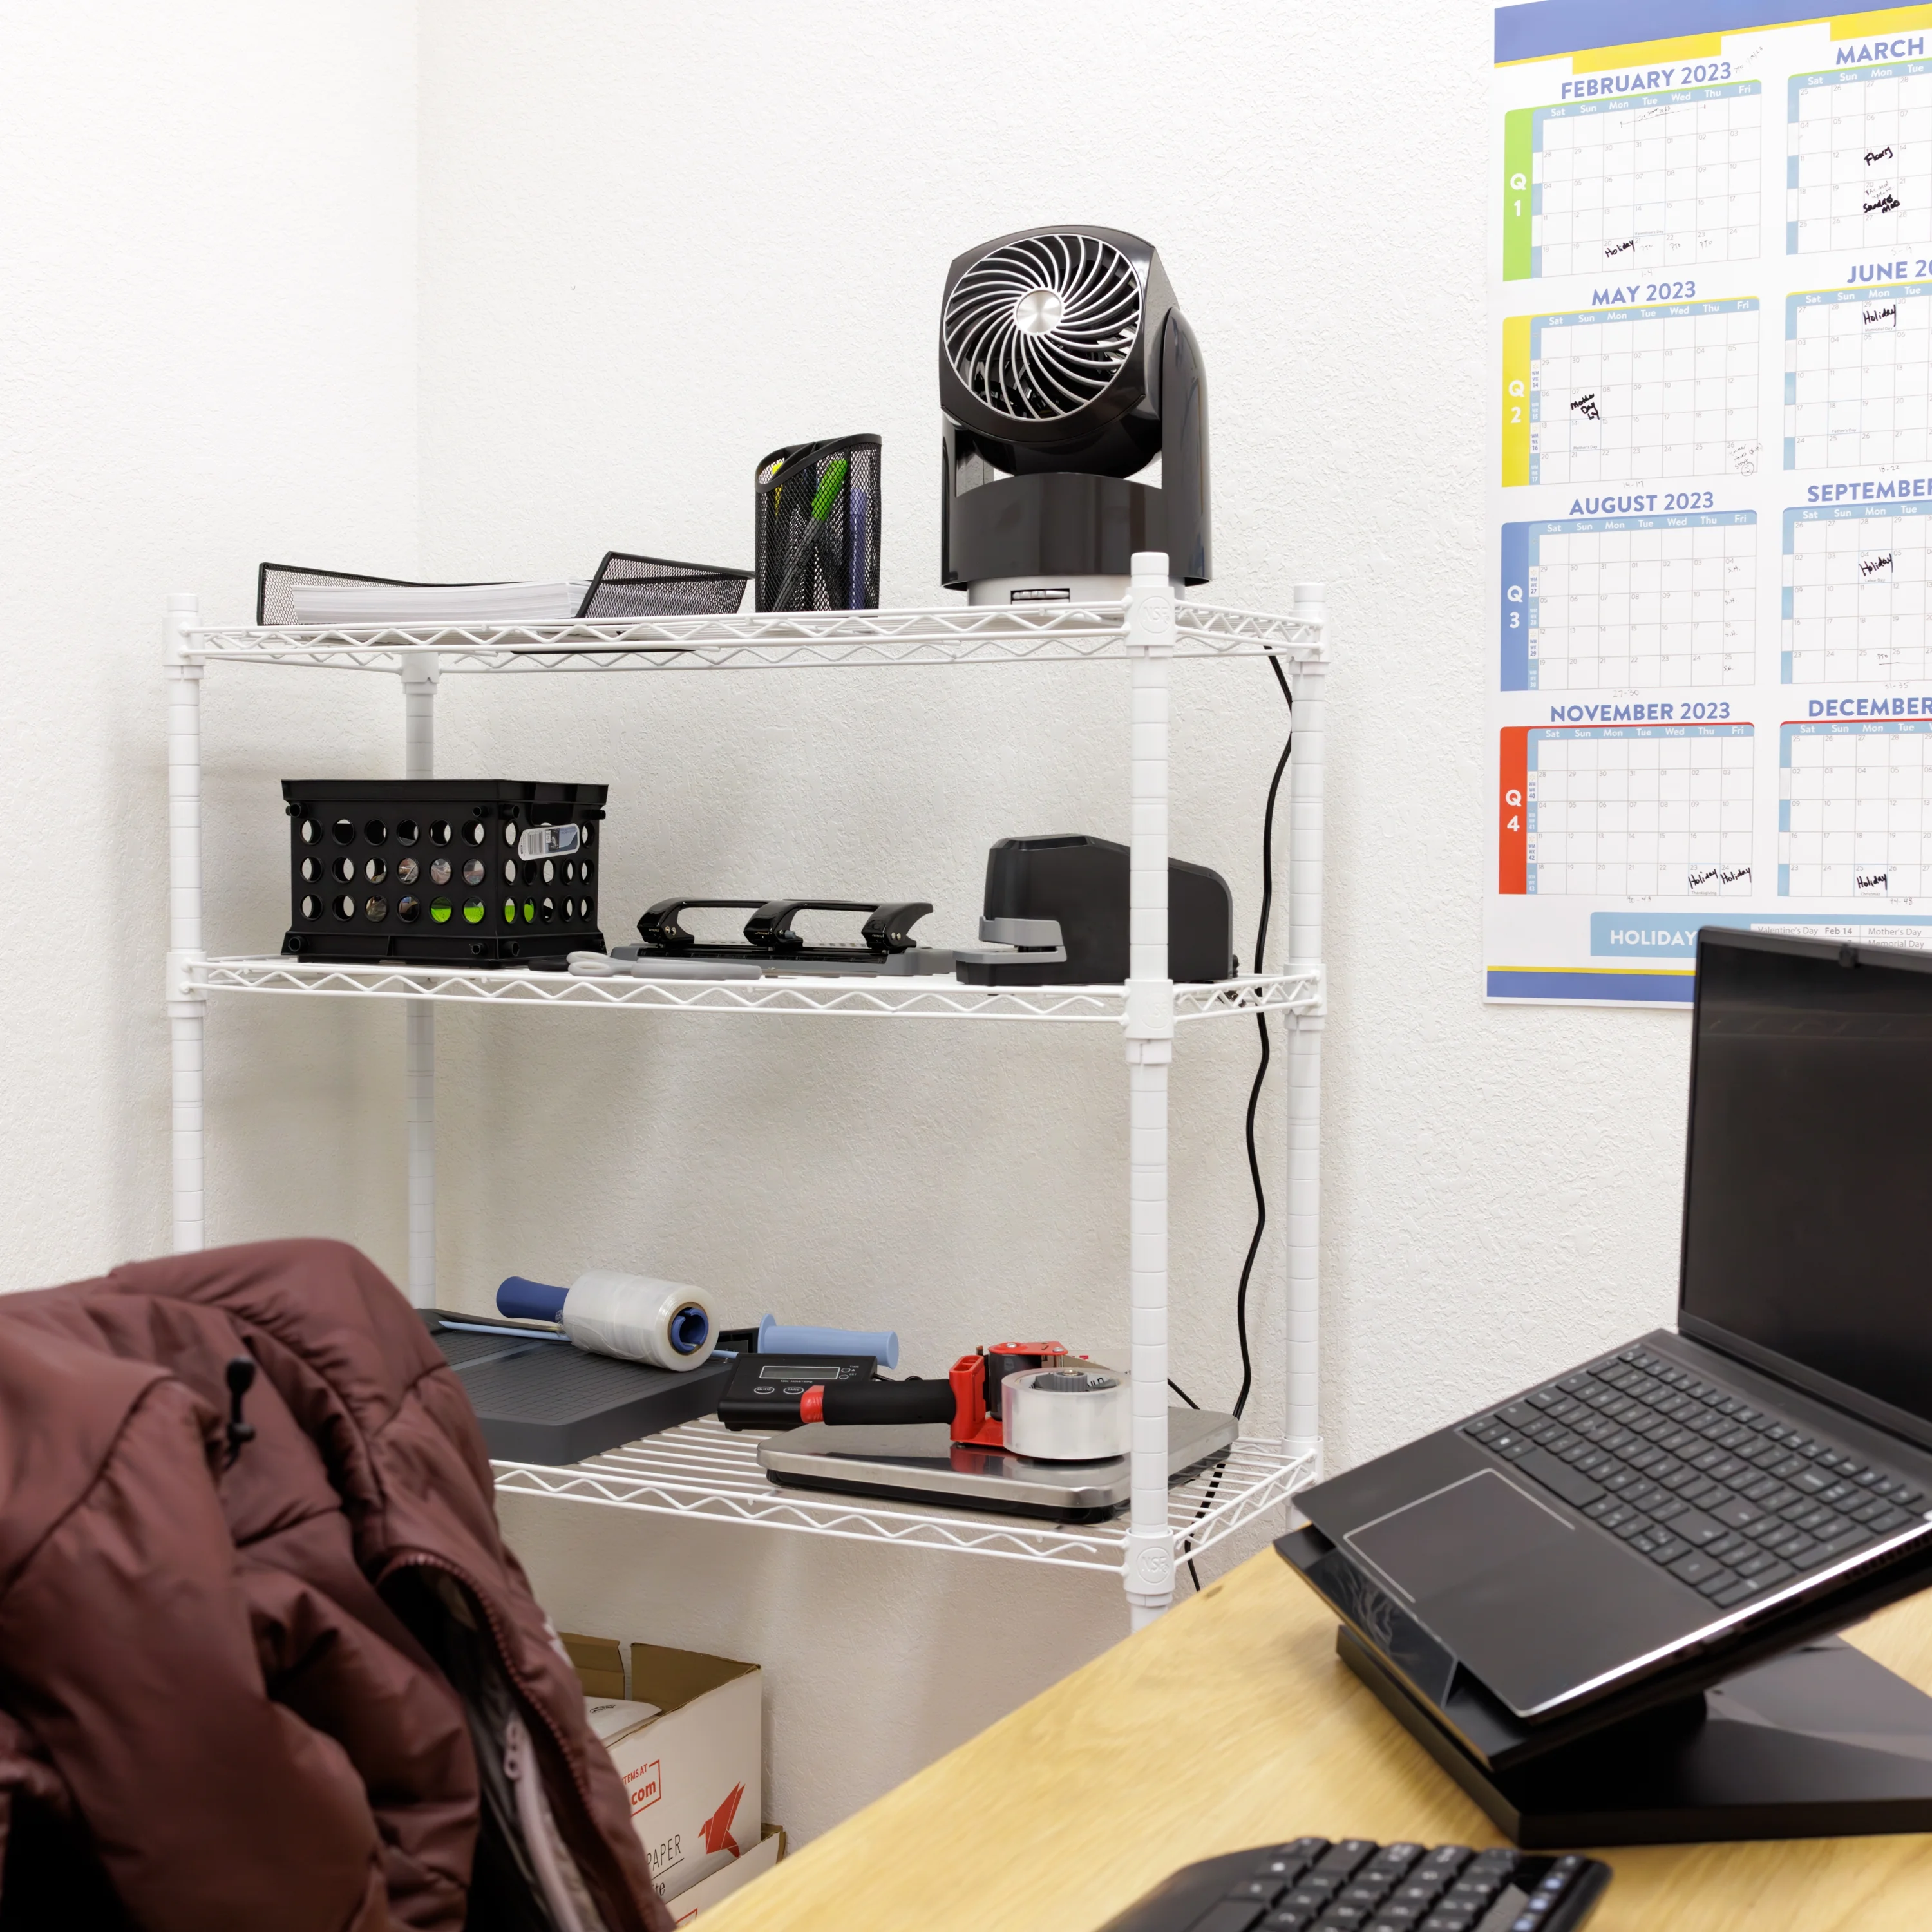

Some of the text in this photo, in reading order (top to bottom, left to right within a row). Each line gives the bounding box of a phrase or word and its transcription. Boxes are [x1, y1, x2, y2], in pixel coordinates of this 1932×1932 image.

[1836, 37, 1924, 65] MARCH
[1562, 62, 1731, 99] FEBRUARY 2023
[1808, 64, 1924, 86] Sat Sun Mon Tue
[1551, 85, 1751, 117] Sat Sun Mon Tue Wed Thu Fri
[1510, 173, 1526, 190] Q
[1514, 200, 1521, 216] 1
[1605, 240, 1635, 258] Holiday
[1847, 261, 1908, 283] JUNE
[1592, 281, 1696, 306] MAY 2023
[1869, 290, 1889, 298] Mon
[1905, 287, 1921, 295] Tue
[1549, 317, 1563, 325] Sat
[1607, 312, 1627, 320] Mon
[1669, 306, 1689, 315] Wed
[1703, 304, 1719, 312] Thu
[1737, 301, 1749, 310] Fri
[1863, 305, 1896, 327] Holiday
[1509, 379, 1524, 397] Q
[1511, 406, 1521, 423] 2
[1569, 491, 1714, 515] AUGUST 2023
[1667, 518, 1687, 526] Wed
[1735, 515, 1747, 523] Fri
[1803, 511, 1818, 519] Sat
[1865, 507, 1886, 516] Mon
[1859, 553, 1893, 576] Holiday
[1507, 585, 1523, 602] Q
[1510, 612, 1520, 628] 3
[1551, 702, 1730, 722] NOVEMBER 2023
[1732, 726, 1744, 735] Fri
[1506, 789, 1522, 806] Q
[1507, 815, 1520, 832] 4
[1689, 868, 1718, 889] Holiday
[1720, 867, 1752, 885] Holiday
[1857, 874, 1887, 890] Holiday
[1803, 927, 1818, 936] Day
[1906, 929, 1922, 937] Day
[1908, 940, 1924, 949] Day
[622, 1764, 648, 1785] TEMS AT
[647, 1834, 681, 1871] PAPER
